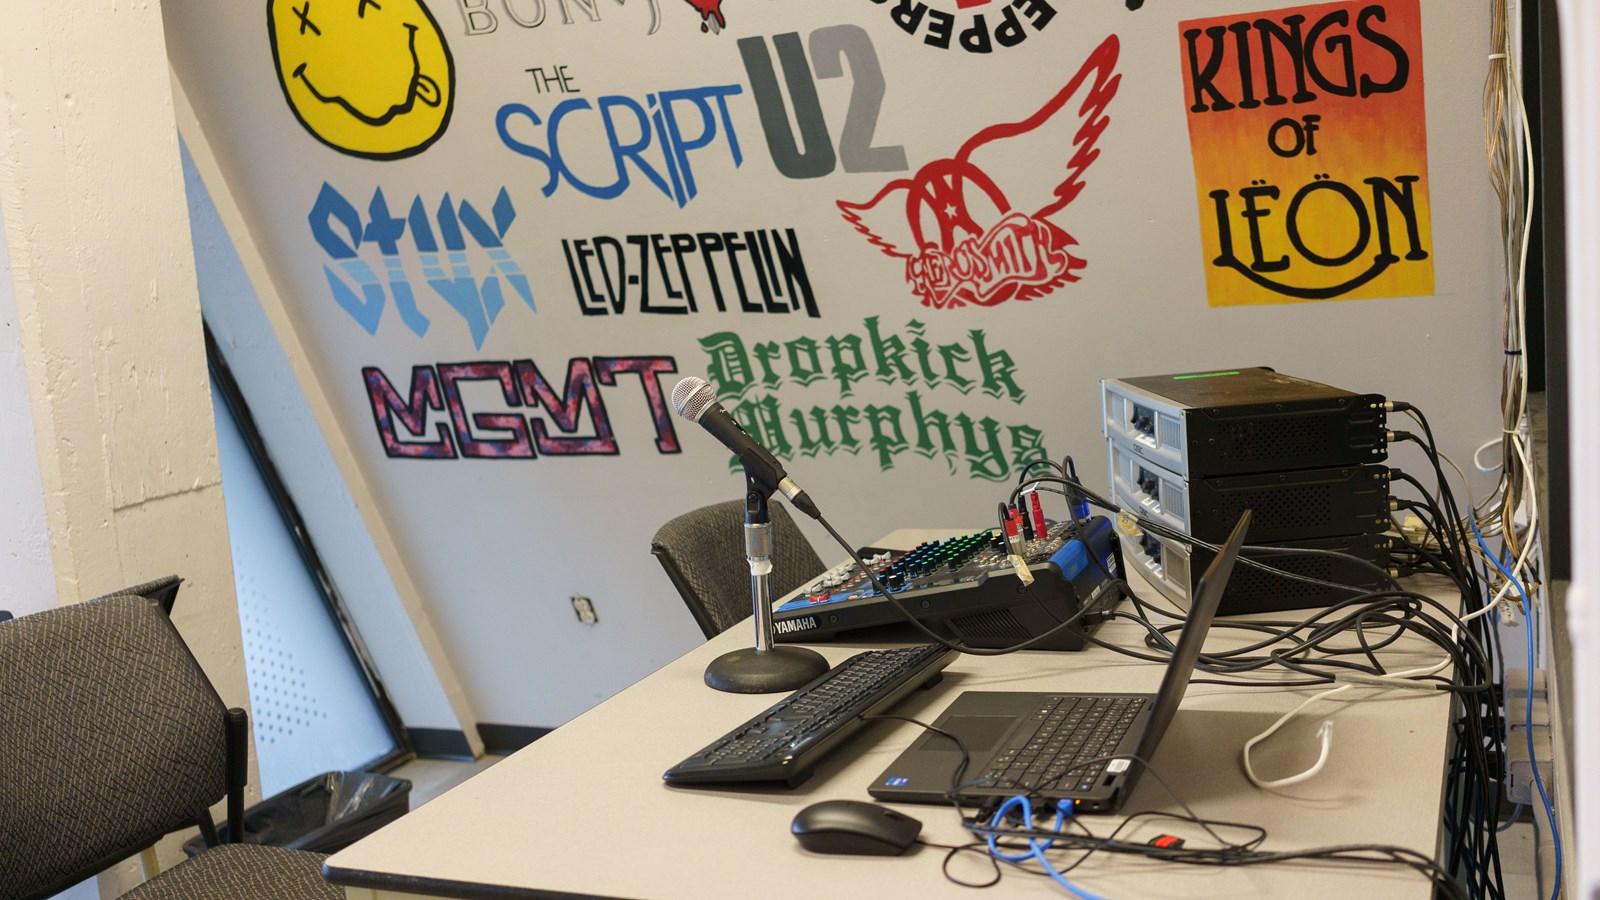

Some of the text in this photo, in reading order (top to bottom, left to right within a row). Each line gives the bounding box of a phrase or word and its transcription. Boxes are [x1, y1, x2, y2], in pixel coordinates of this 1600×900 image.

[872, 0, 1058, 54] EPPER
[1183, 5, 1410, 113] KINGS
[525, 65, 581, 94] THE
[737, 24, 910, 180] U2
[696, 315, 1027, 405] Dropkick
[361, 355, 682, 460] MGMT
[727, 389, 1052, 483] Murphys
[774, 616, 817, 634] YAMAHA
